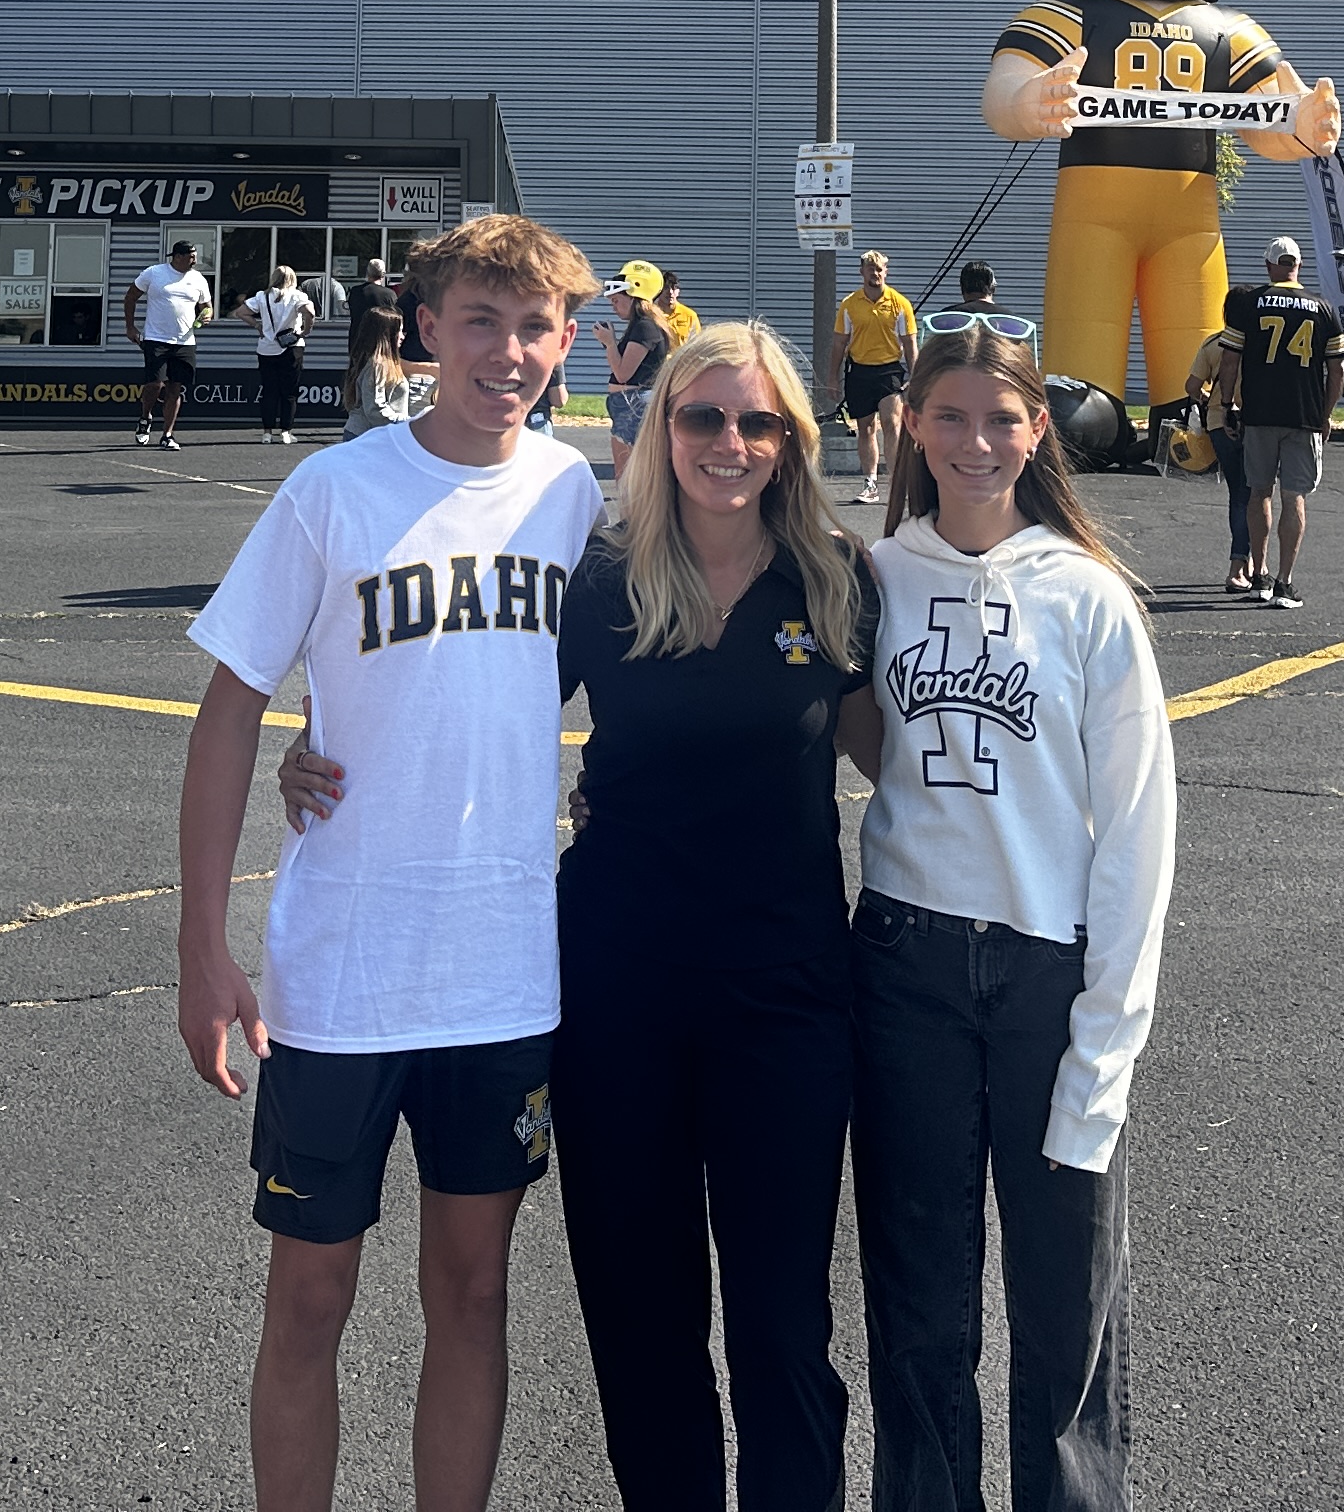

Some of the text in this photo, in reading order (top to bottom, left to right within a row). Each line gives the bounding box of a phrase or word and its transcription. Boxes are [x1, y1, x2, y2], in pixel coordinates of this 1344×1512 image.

[1129, 21, 1194, 41] IDAHO
[1113, 38, 1207, 94] 89
[1078, 96, 1290, 123] GAME TODAY!
[46, 178, 215, 215] PICKUP
[230, 179, 307, 217] Vandals
[401, 186, 436, 199] WILL
[401, 200, 436, 214] CALL
[2, 284, 45, 296] TICKET
[5, 298, 41, 310] SALES
[1259, 315, 1314, 368] 74
[193, 384, 248, 403] CALL
[297, 385, 342, 407] 208)
[355, 552, 567, 657] IDAHO
[885, 638, 1040, 742] Vandals
